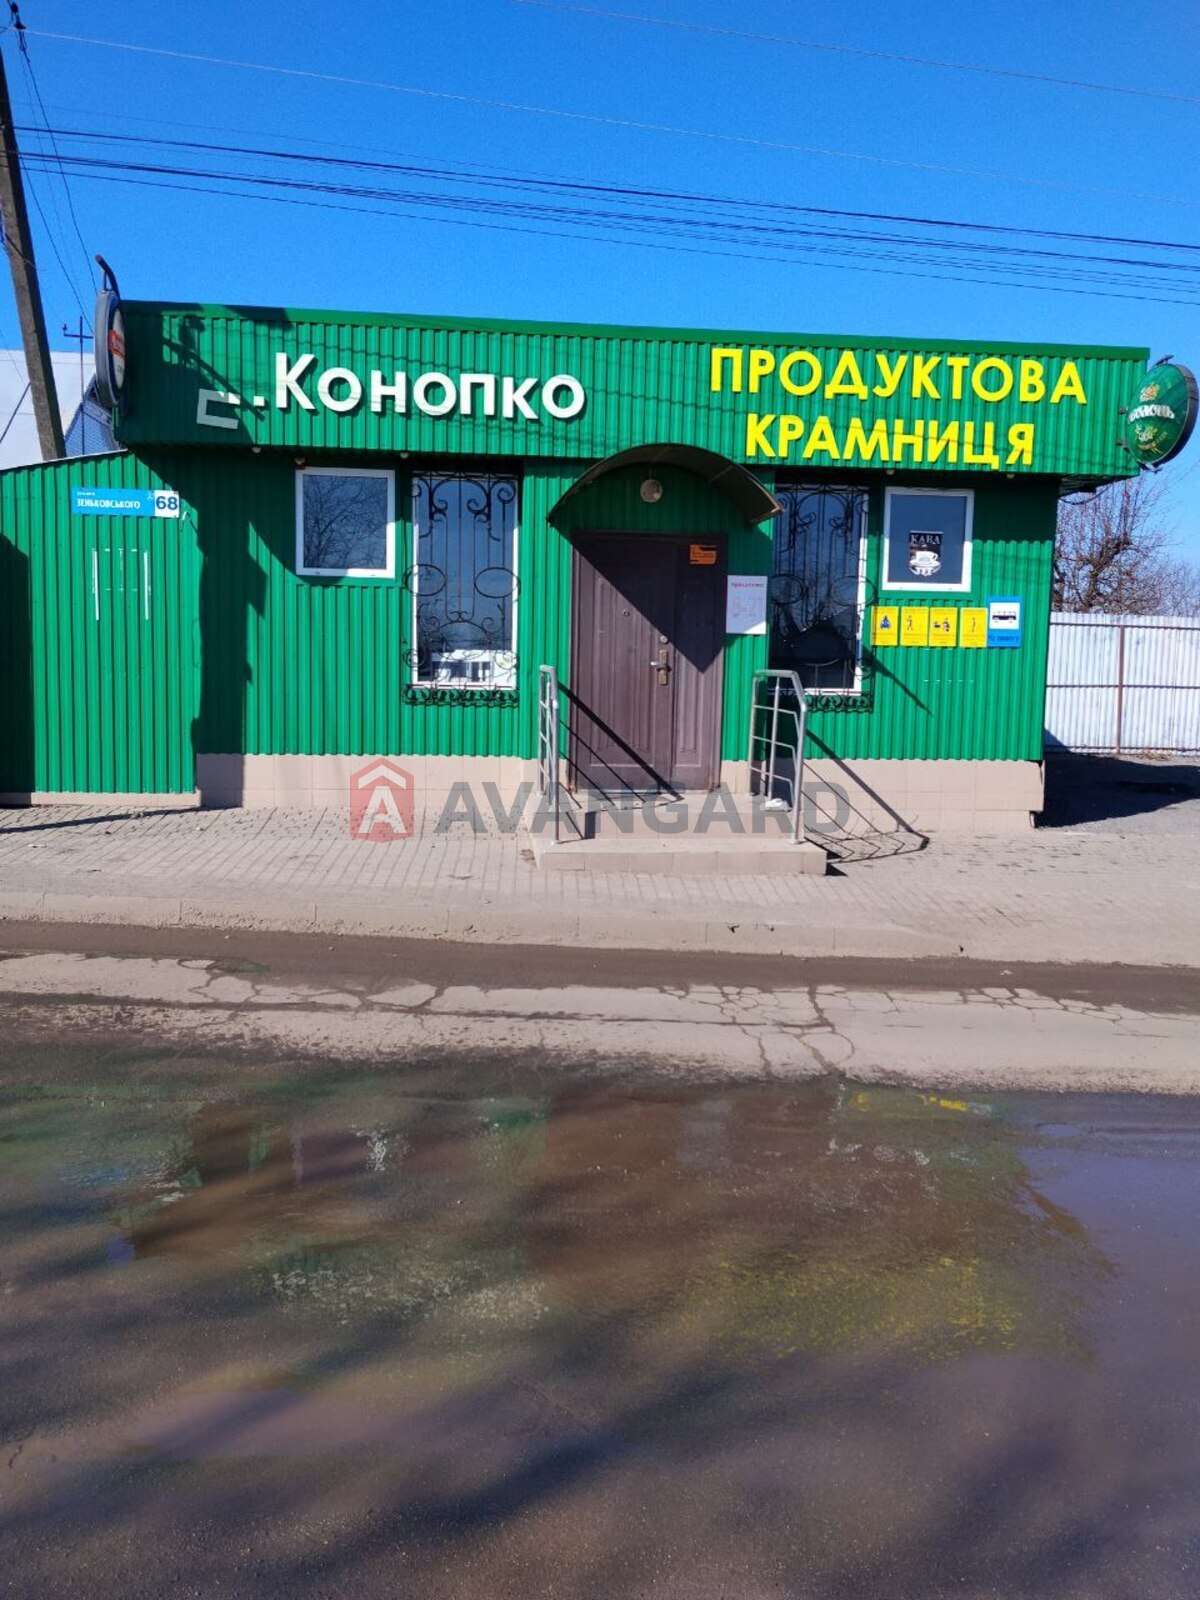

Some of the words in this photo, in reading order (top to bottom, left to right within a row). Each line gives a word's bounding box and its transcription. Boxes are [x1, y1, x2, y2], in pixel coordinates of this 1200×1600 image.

[710, 347, 1087, 405] ПРОДУКТОВА
[745, 412, 1035, 470] КРАМНИЦЯ
[155, 495, 179, 511] 68
